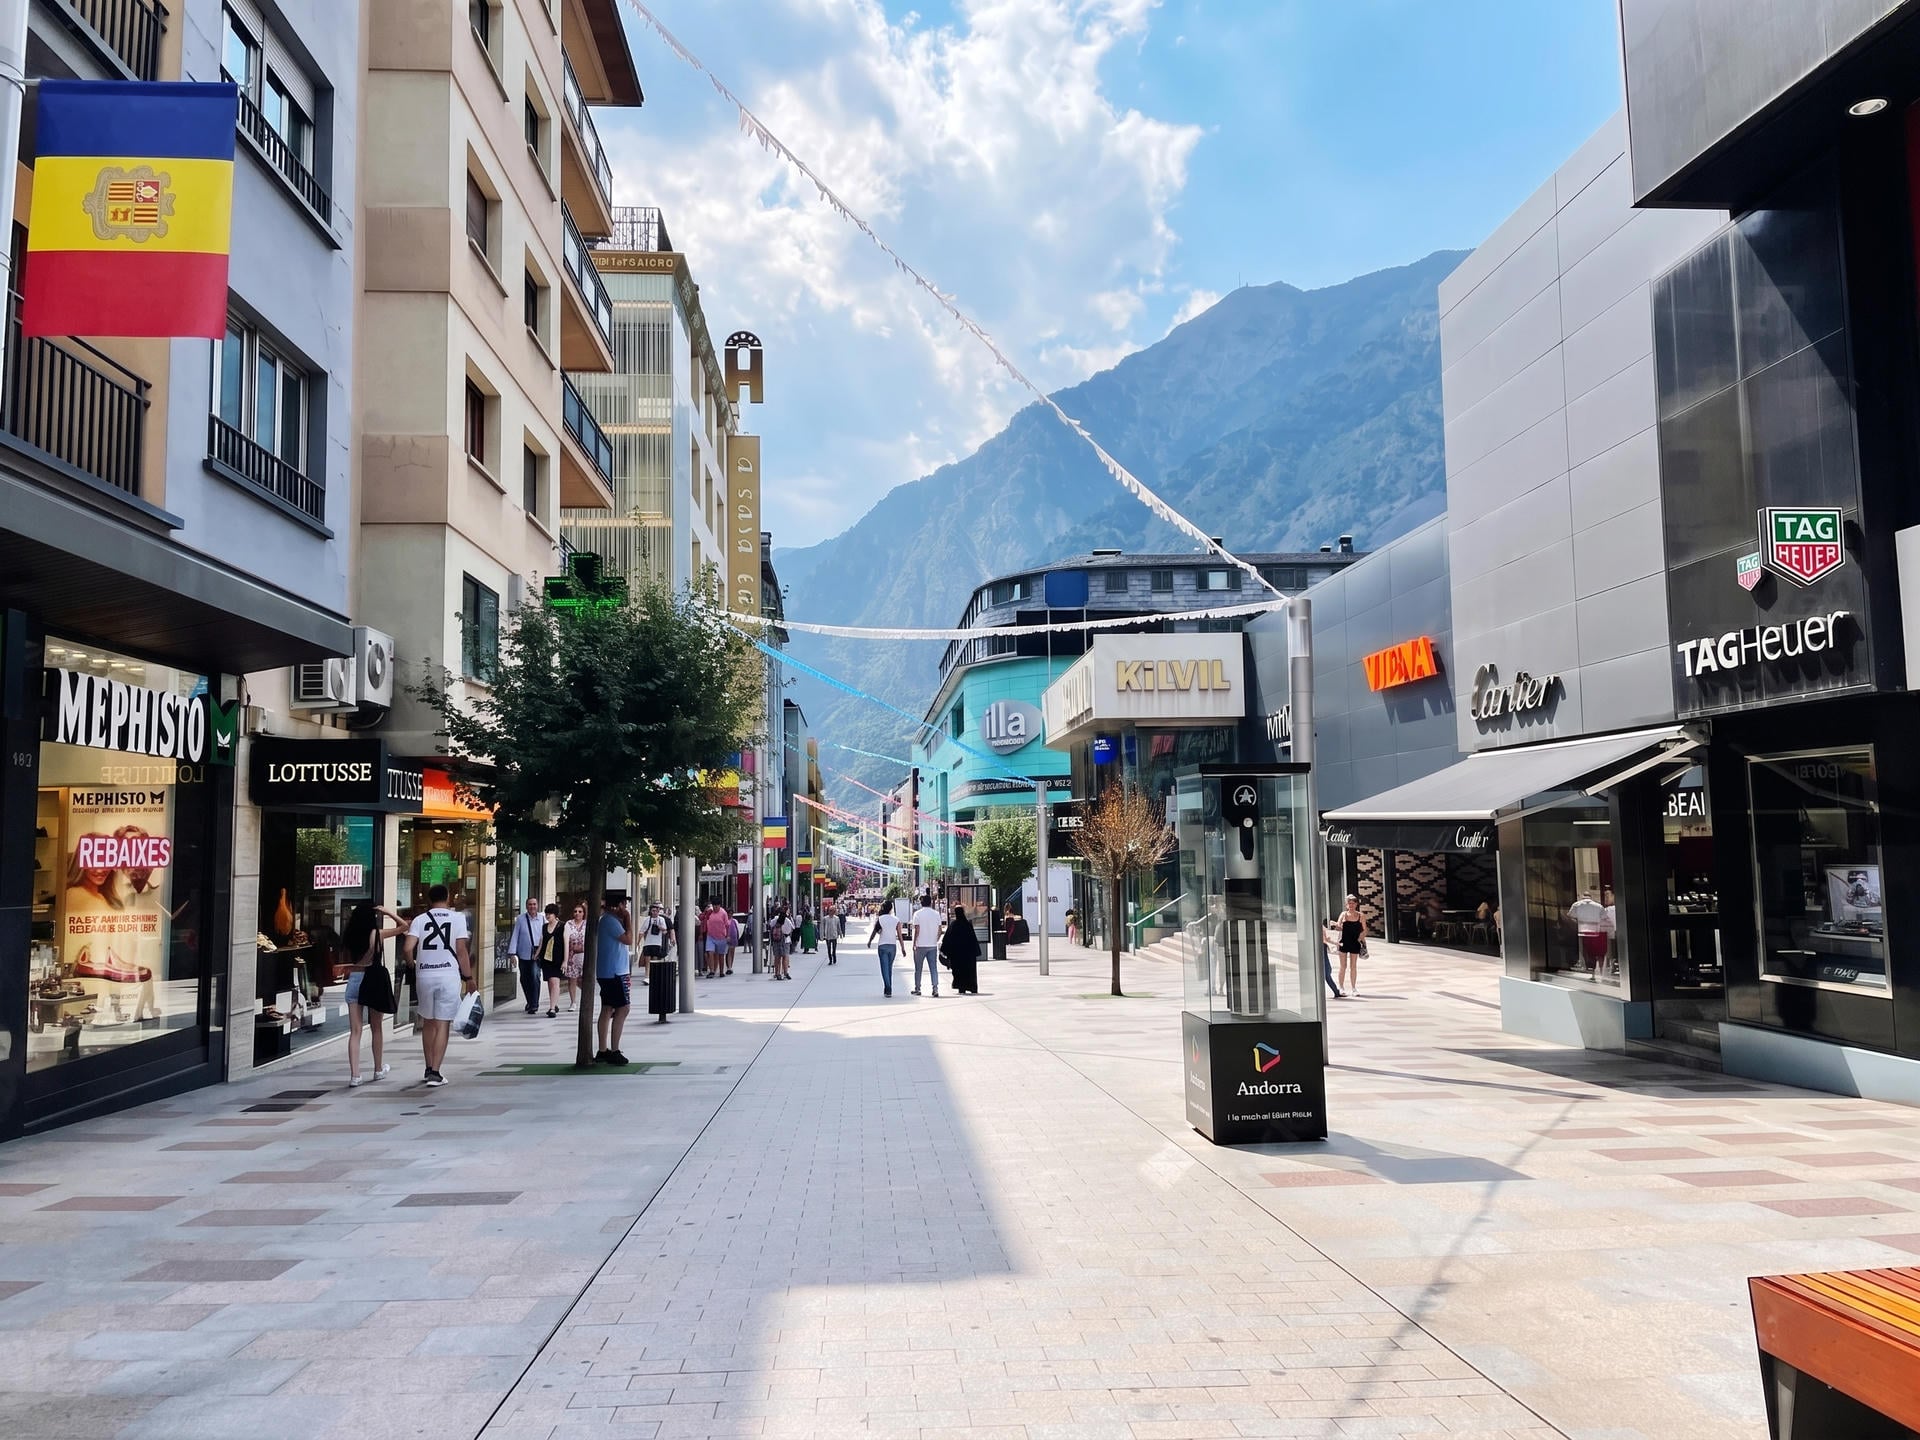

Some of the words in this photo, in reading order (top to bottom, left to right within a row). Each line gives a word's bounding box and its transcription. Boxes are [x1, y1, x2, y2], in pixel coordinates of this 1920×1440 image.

[1778, 517, 1833, 540] TAG
[1778, 545, 1836, 574] HEUER
[55, 667, 205, 763] MEPHISTO
[985, 702, 1026, 739] illa
[268, 763, 372, 783] LOTTUSSE
[72, 792, 146, 806] MEPHISTO
[79, 837, 171, 868] REBAIXES
[1237, 1081, 1303, 1096] Andorra
